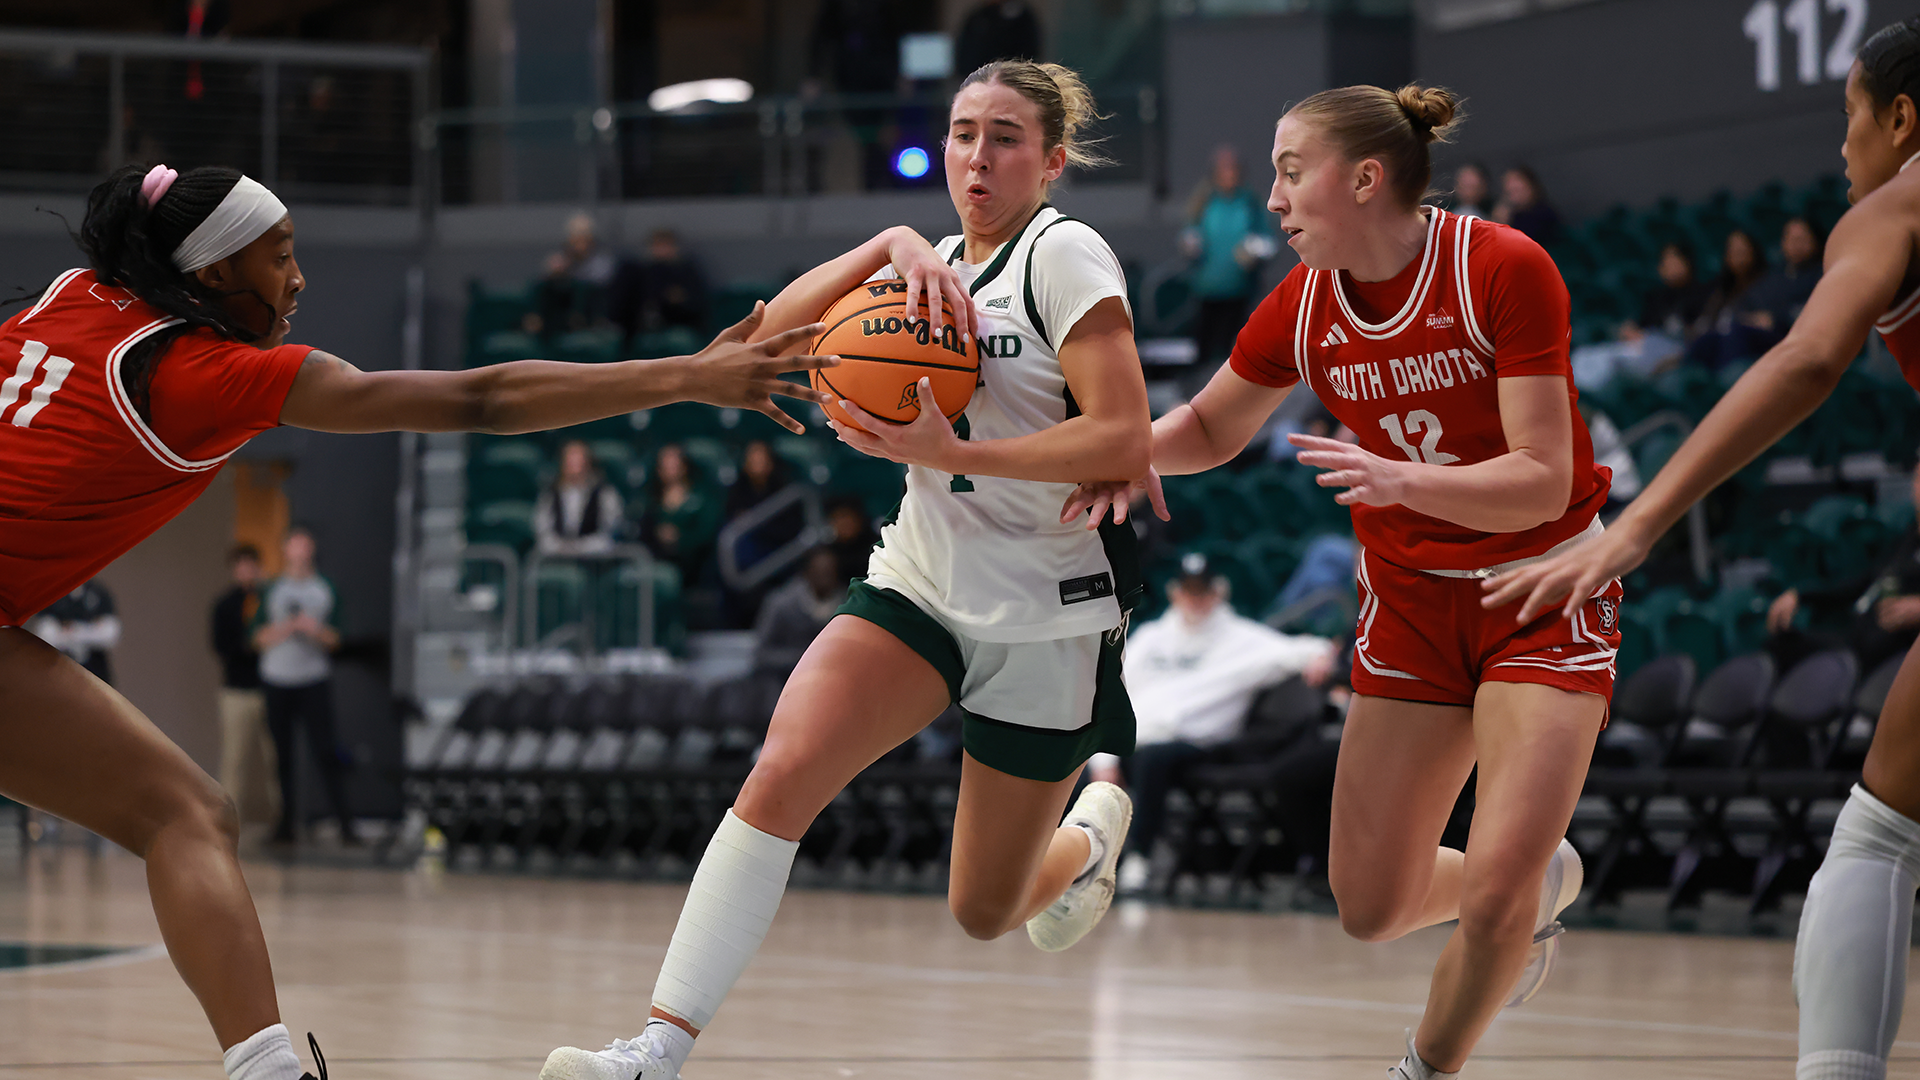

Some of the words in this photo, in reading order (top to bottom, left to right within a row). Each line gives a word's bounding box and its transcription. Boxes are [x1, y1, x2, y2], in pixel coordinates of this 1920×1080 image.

[1742, 0, 1869, 91] 112
[860, 316, 967, 357] Wlson
[0, 340, 75, 428] 11
[1388, 348, 1487, 396] DAKOTA
[1379, 409, 1462, 465] 12
[1095, 580, 1105, 591] M
